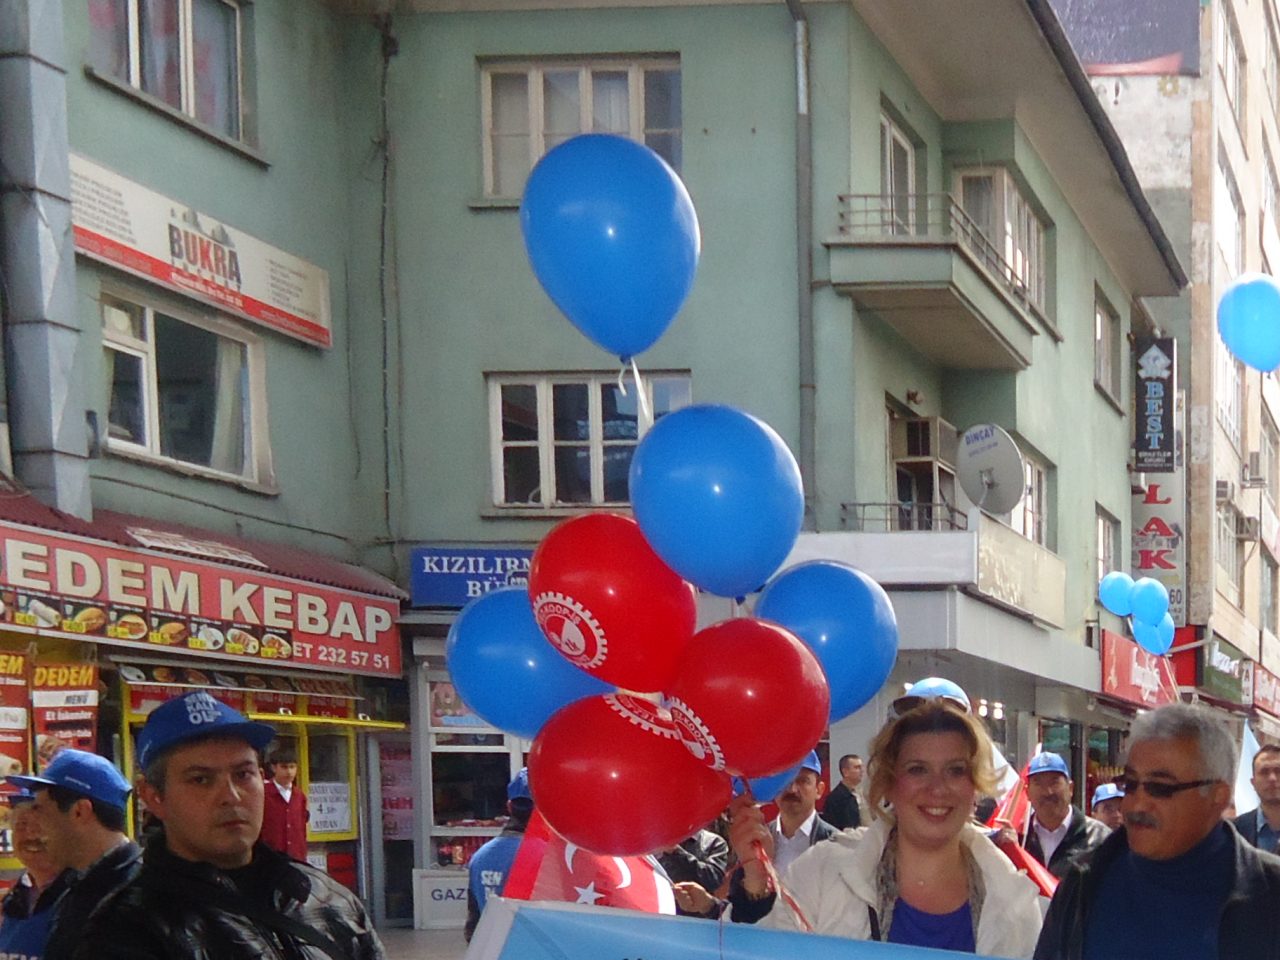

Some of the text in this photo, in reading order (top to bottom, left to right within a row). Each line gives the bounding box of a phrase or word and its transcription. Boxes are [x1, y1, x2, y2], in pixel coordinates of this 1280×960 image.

[168, 223, 241, 285] BUKRA
[1145, 382, 1164, 449] BEST
[220, 578, 392, 643] KEBAP
[33, 664, 95, 687] DEDEM
[318, 645, 346, 664] 232
[351, 651, 369, 666] 57
[373, 654, 390, 669] 51
